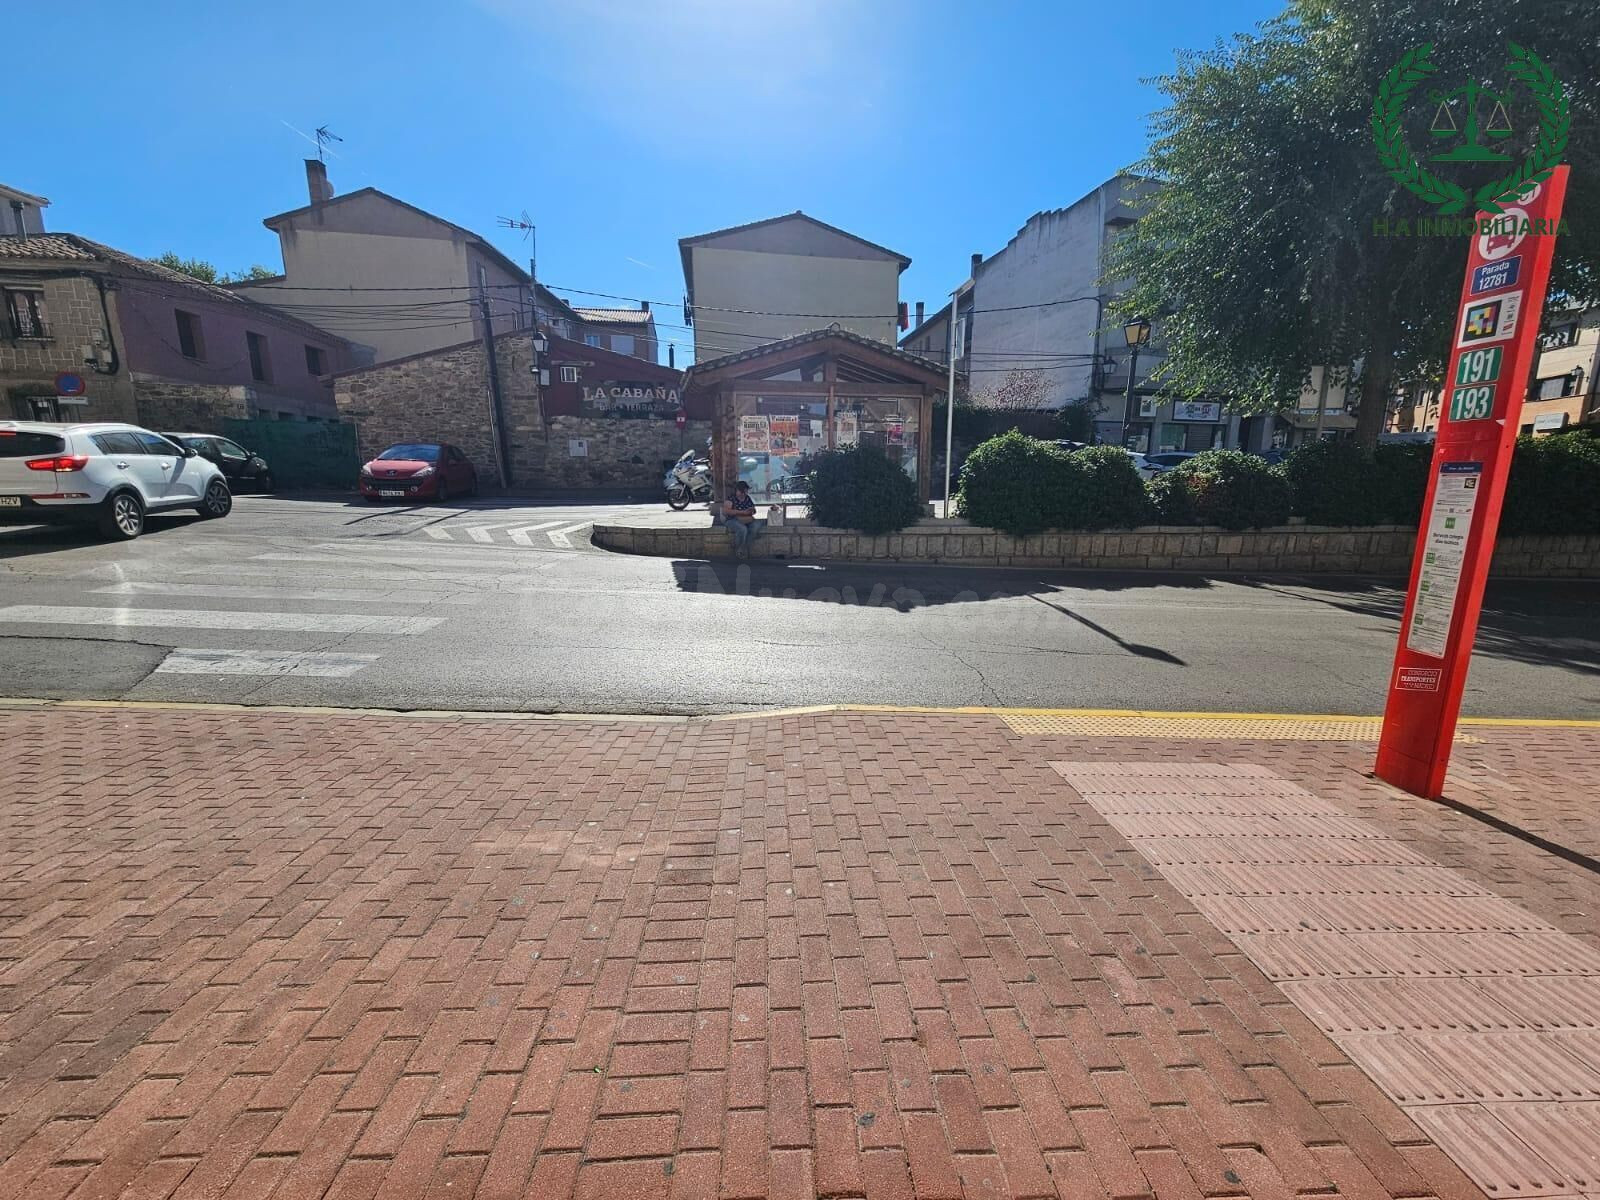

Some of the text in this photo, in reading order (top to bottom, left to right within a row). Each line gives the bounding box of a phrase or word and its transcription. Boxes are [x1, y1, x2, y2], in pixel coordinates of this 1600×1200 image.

[1482, 261, 1510, 275] Parada
[1479, 273, 1507, 290] 12781
[1463, 348, 1495, 384] 191
[582, 386, 680, 404] LA CABAÑA
[1455, 386, 1490, 420] 193
